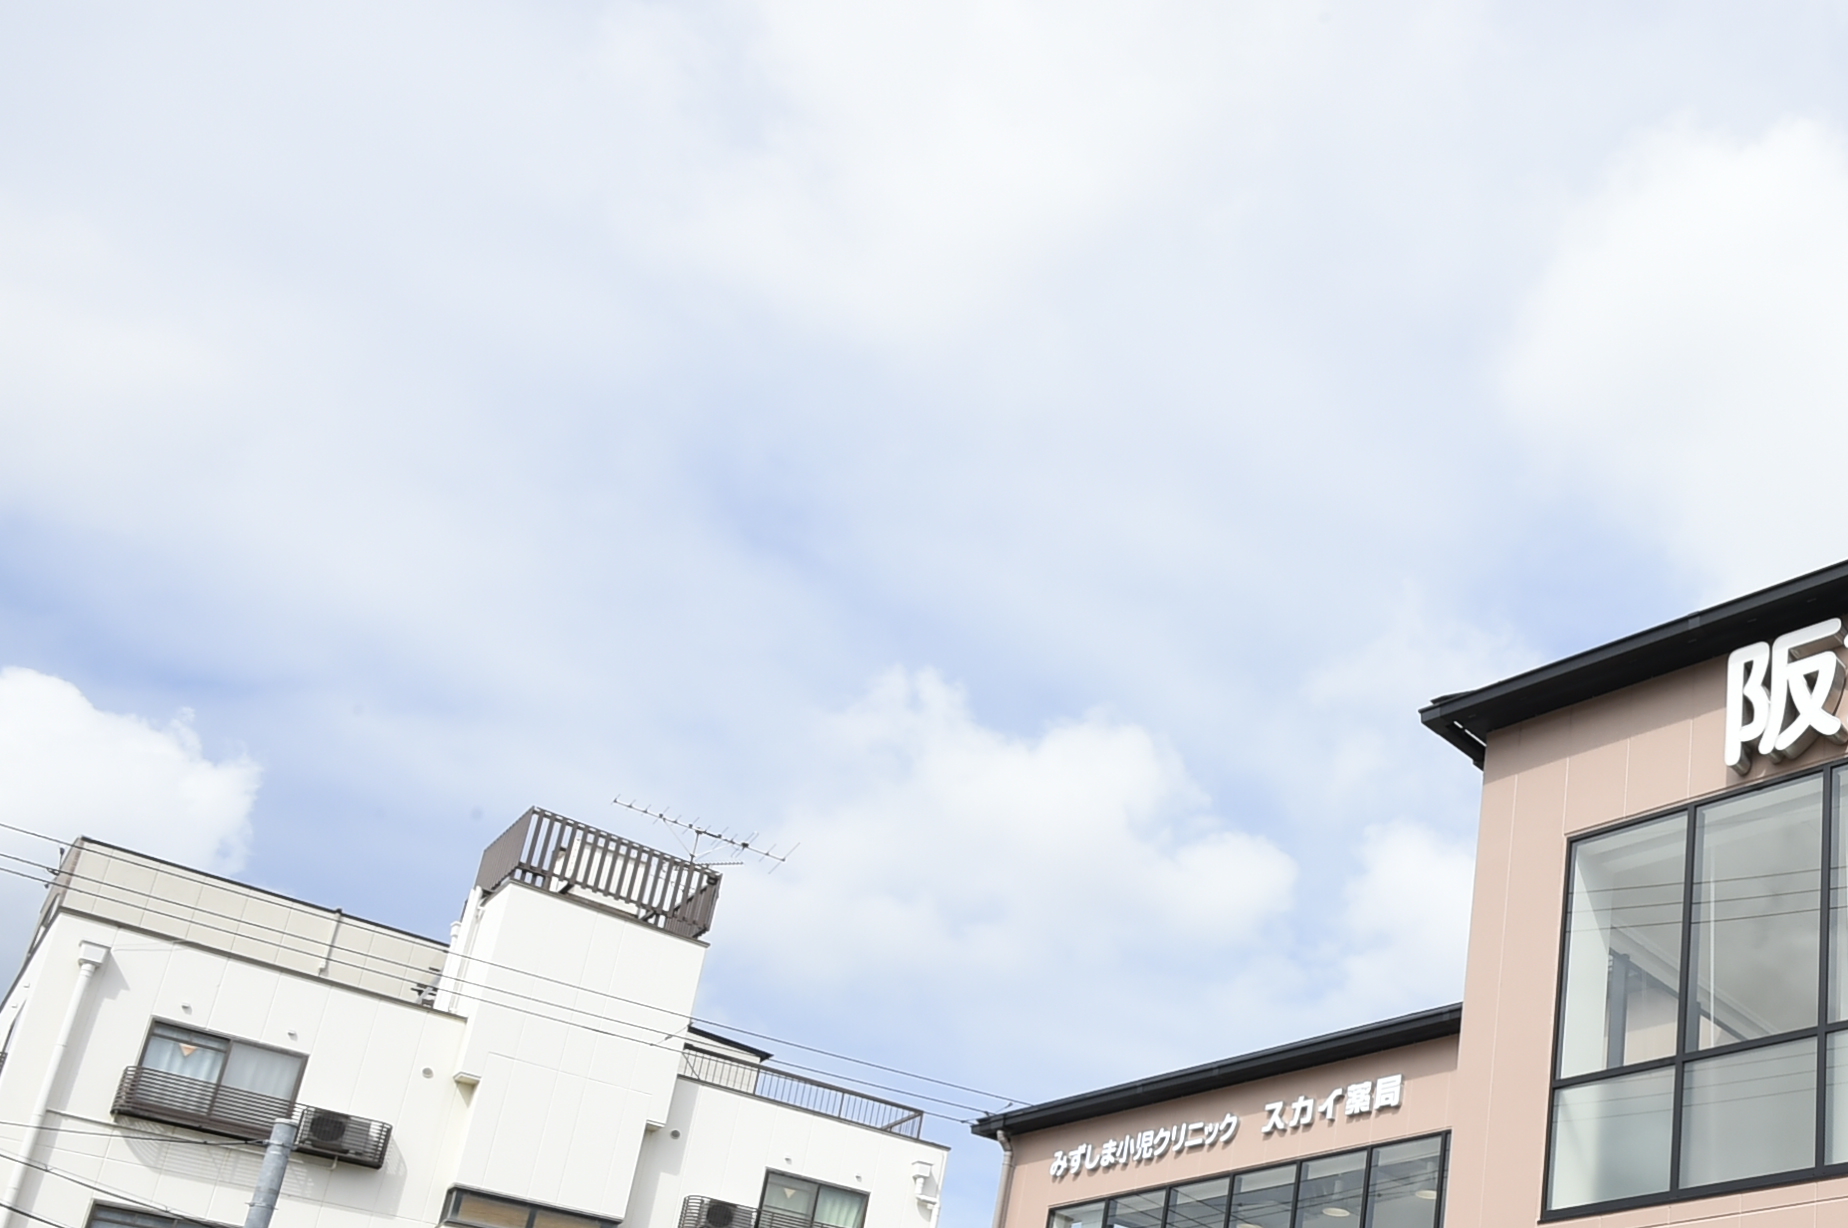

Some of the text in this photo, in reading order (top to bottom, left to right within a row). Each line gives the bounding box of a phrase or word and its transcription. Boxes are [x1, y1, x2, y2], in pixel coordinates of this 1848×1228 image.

[1050, 1073, 1404, 1177] みずしま小児クリニック スカイ薬局
